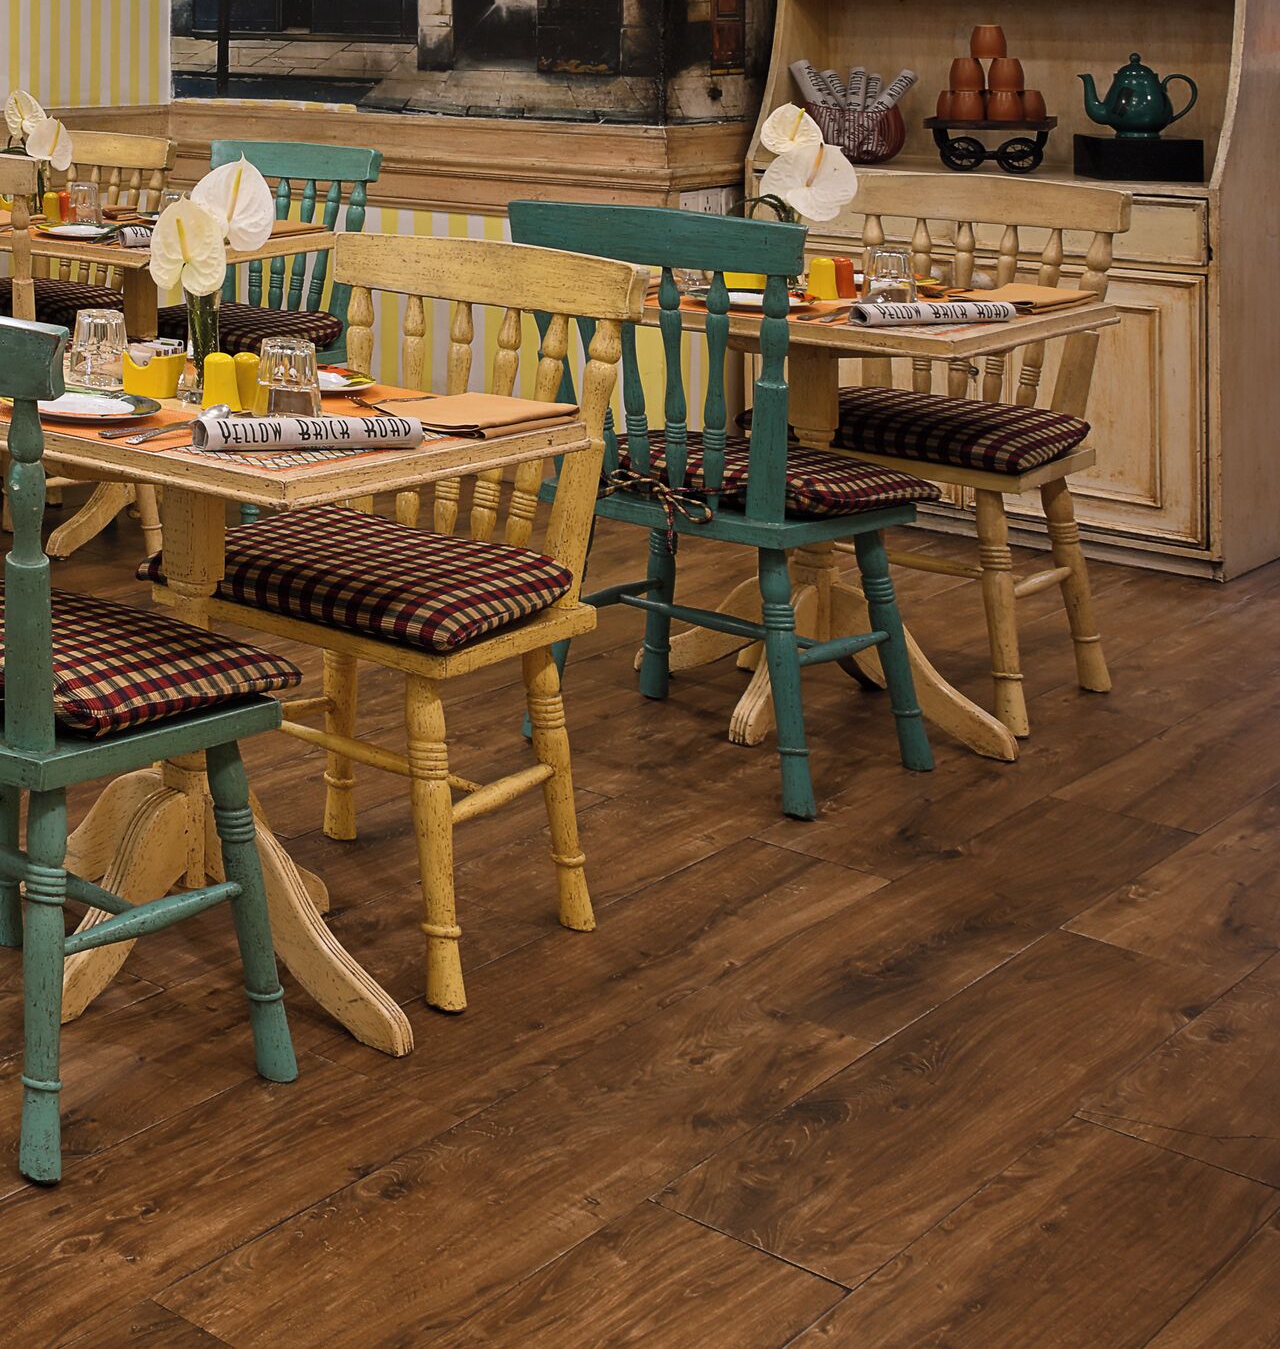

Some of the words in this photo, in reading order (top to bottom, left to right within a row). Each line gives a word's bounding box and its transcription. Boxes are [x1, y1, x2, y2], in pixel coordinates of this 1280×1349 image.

[873, 304, 922, 320] YELLOW
[927, 303, 968, 319] BRICK
[972, 302, 1010, 319] ROAD
[217, 420, 282, 444] YELLOW
[295, 419, 351, 441] BRICK
[361, 417, 412, 438] ROAD
